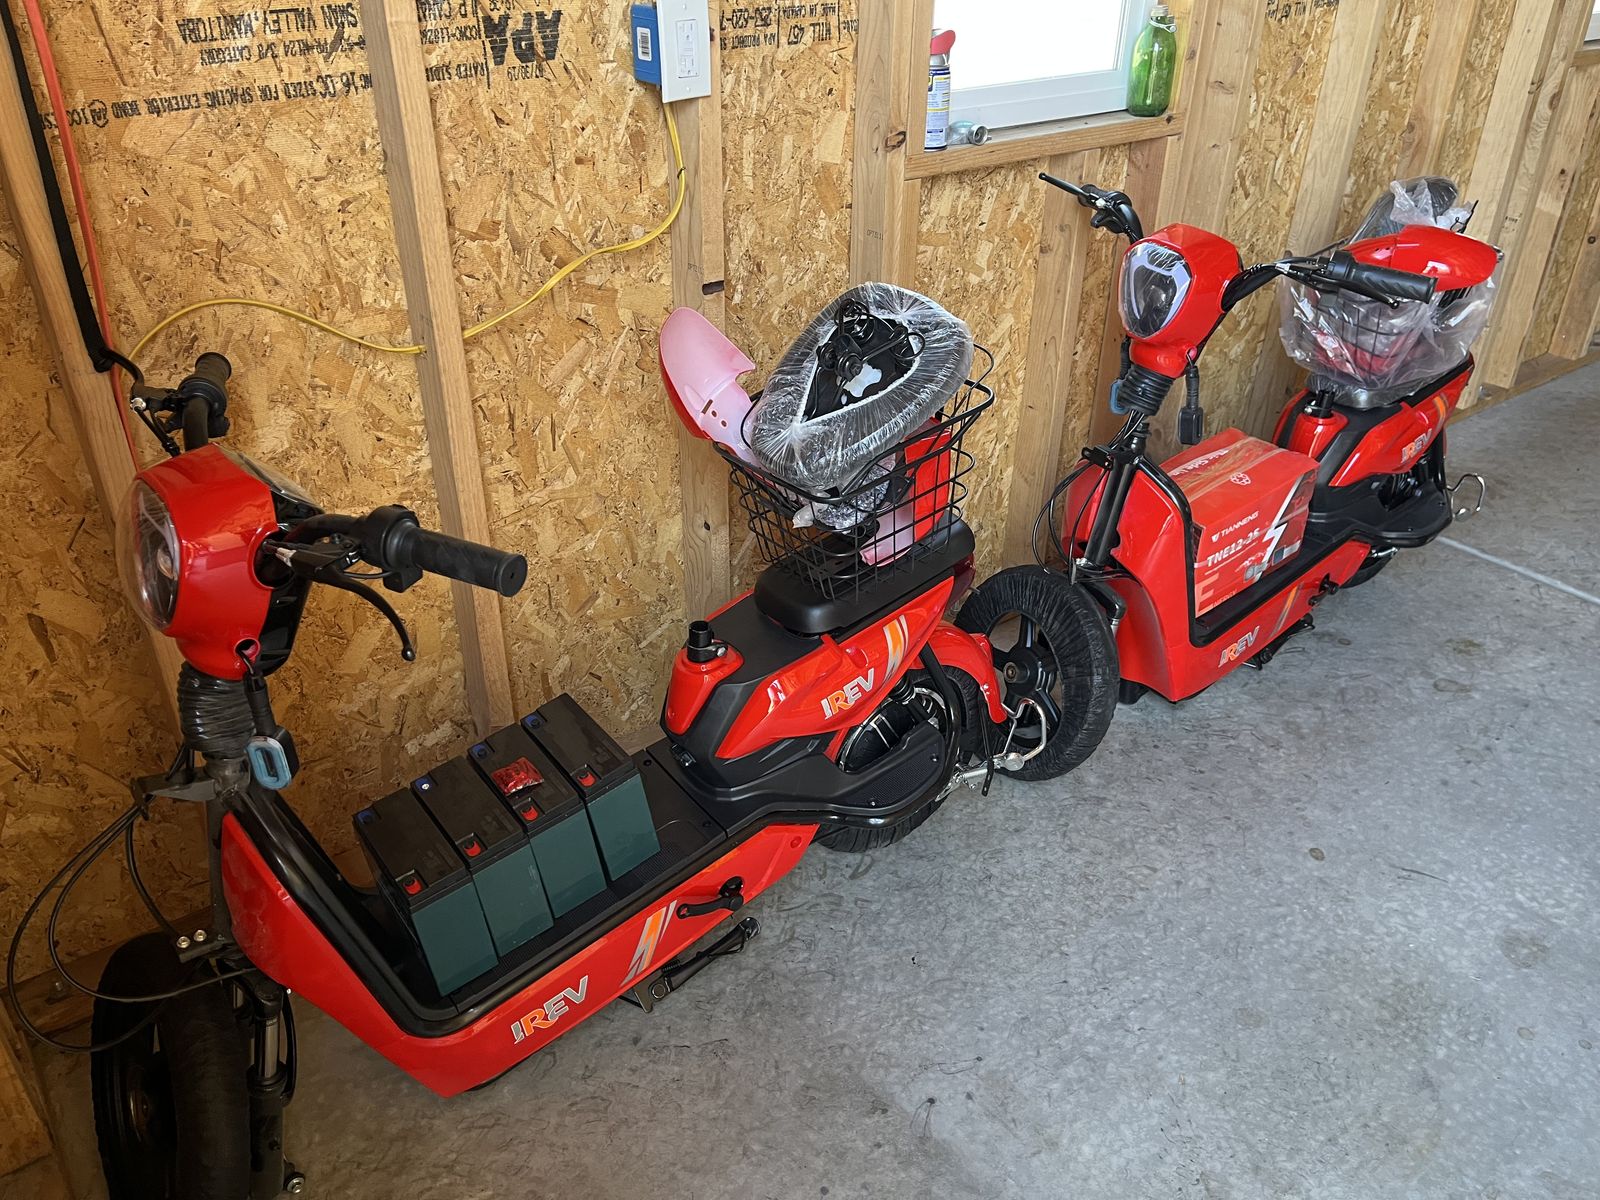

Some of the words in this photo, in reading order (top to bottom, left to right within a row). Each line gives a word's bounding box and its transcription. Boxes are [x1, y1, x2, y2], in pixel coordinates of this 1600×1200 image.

[320, 2, 358, 30] SWAN
[482, 9, 563, 66] APA
[456, 61, 485, 80] RATED
[257, 84, 280, 102] FOR
[283, 80, 314, 99] SIZED
[340, 71, 359, 97] 16
[112, 100, 141, 119] BOND
[143, 93, 201, 117] EXTERIOR
[204, 87, 254, 109] SPACING
[820, 667, 875, 720] IREV
[511, 974, 589, 1045] IREV
